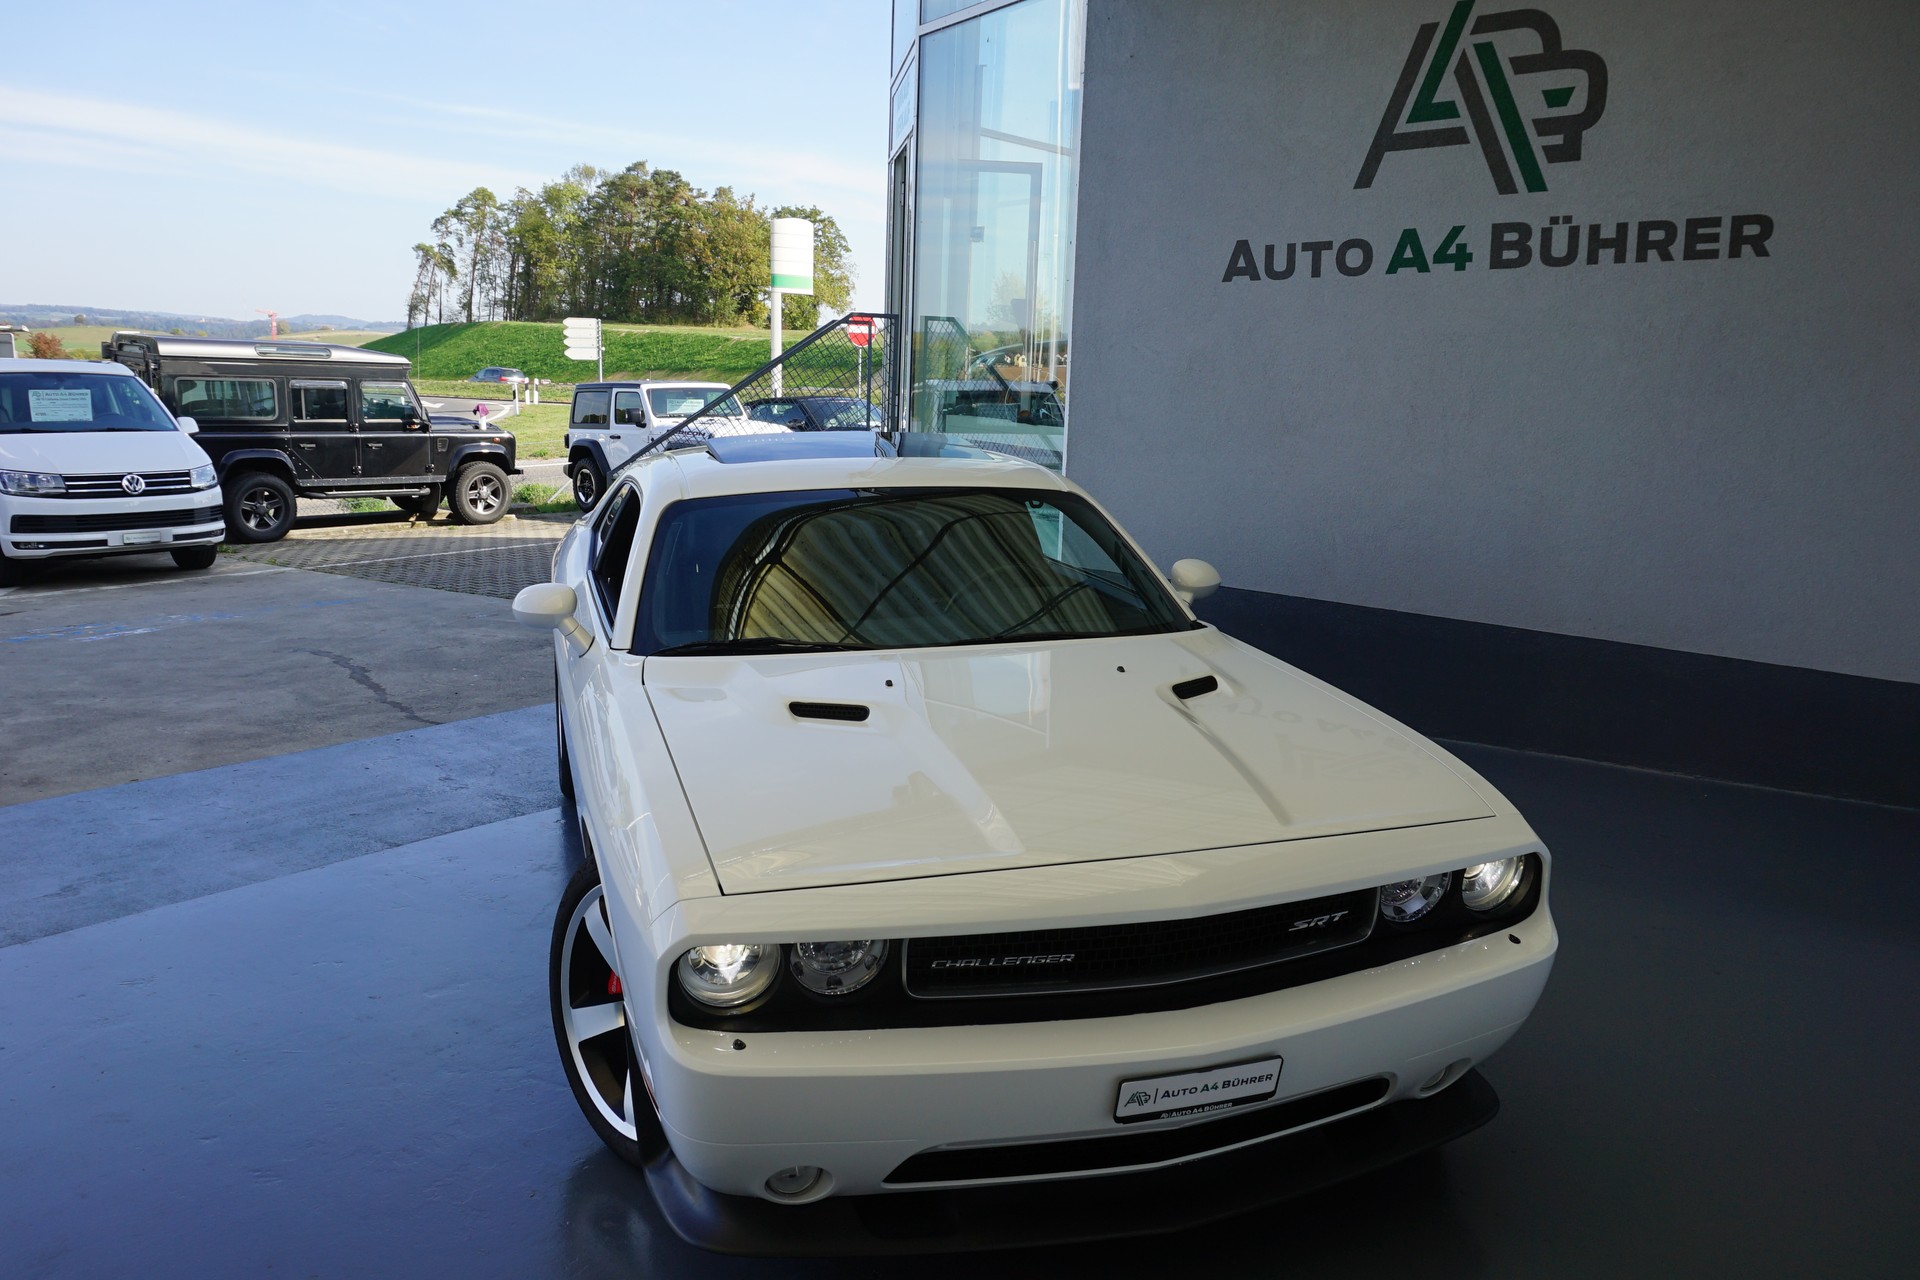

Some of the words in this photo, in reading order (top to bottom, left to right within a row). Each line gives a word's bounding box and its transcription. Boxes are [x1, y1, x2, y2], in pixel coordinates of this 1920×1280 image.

[1221, 237, 1374, 283] AUTO
[1385, 224, 1474, 275] A4
[1488, 213, 1775, 270] BÜHRER
[1288, 910, 1349, 931] SRT
[931, 953, 1076, 969] CHALLENGER
[1161, 1086, 1198, 1100] AUTO
[1199, 1081, 1219, 1094] A4
[1221, 1073, 1274, 1090] BÜHRER
[1171, 1109, 1192, 1117] AUTO
[1192, 1103, 1203, 1114] A4
[1203, 1102, 1233, 1112] BÜHRER
